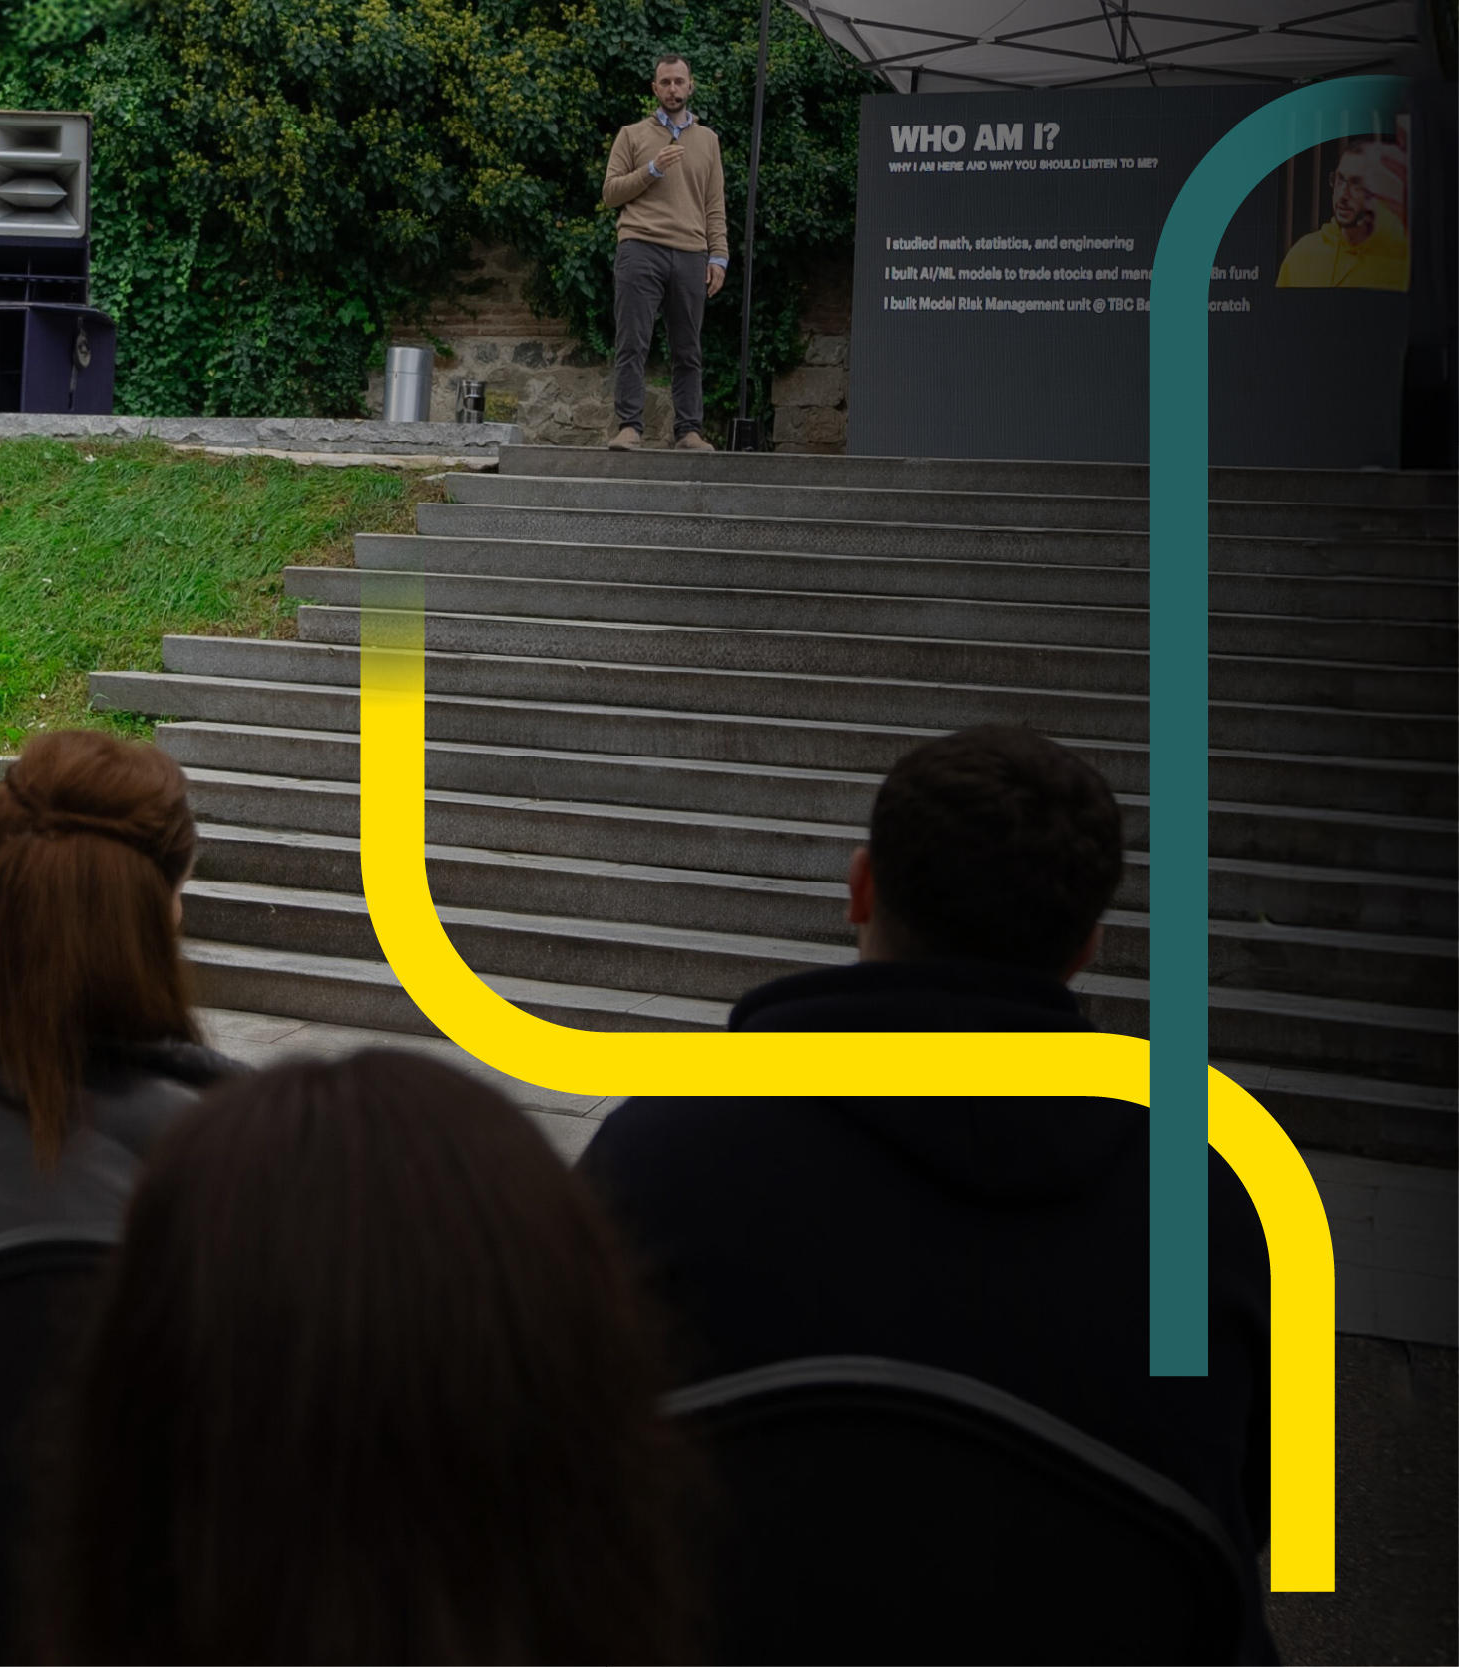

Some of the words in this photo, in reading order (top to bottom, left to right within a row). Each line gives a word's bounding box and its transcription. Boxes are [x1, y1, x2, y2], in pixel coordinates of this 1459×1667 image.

[890, 125, 967, 153] WHO
[973, 123, 1024, 151] AM
[1033, 122, 1061, 151] I?
[888, 161, 912, 173] WHY
[918, 161, 936, 172] AM
[937, 161, 965, 172] HERE
[966, 160, 988, 171] AND
[989, 160, 1014, 171] WHY
[1015, 159, 1038, 171] YOU
[1039, 159, 1081, 170] SHOULD
[1082, 158, 1118, 170] LISTEN
[1119, 158, 1135, 169] TO
[1137, 158, 1159, 169] ME?
[892, 236, 938, 250] studied
[938, 235, 973, 252] math,
[975, 235, 1032, 252] statistics,
[1034, 235, 1058, 250] and
[1059, 235, 1135, 252] engineering
[891, 266, 918, 280] built
[919, 266, 956, 283] AI/ML
[957, 266, 1003, 280] models
[1004, 267, 1017, 281] to
[1018, 265, 1051, 281] trade
[1052, 265, 1094, 281] stocks
[1095, 265, 1119, 281] and
[1228, 265, 1260, 281] fund
[889, 295, 918, 310] built
[919, 295, 956, 310] Model
[957, 295, 983, 310] Risk
[985, 296, 1065, 314] Management
[1066, 296, 1092, 311] unit
[1092, 298, 1107, 314] @
[1107, 297, 1135, 311] TBC
[1136, 297, 1151, 311] Ba
[1208, 296, 1251, 312] cratch
